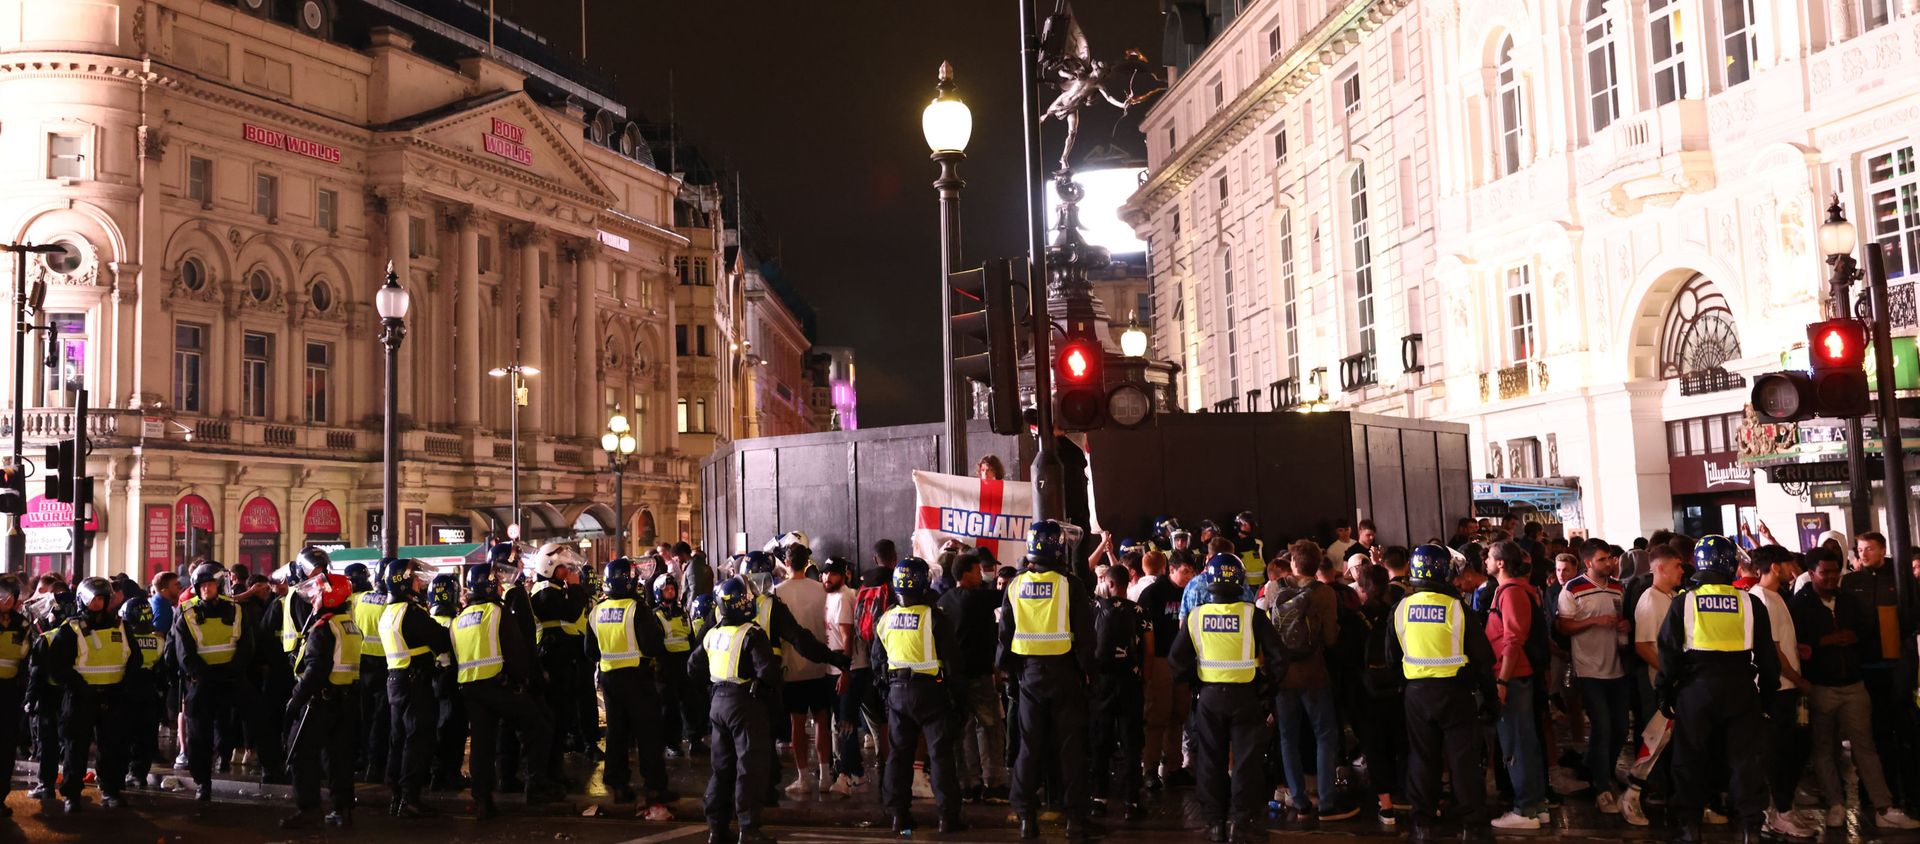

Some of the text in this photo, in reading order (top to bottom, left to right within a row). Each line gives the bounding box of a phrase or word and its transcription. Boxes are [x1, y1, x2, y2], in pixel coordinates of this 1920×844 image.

[494, 117, 526, 144] BODY
[244, 124, 341, 163] BODY WORLDS
[483, 133, 532, 165] WORLDS
[1703, 460, 1750, 488] Lillywhites
[1039, 480, 1045, 489] 7
[1020, 584, 1051, 596] POLICE
[1698, 597, 1737, 610] POLICE
[1409, 607, 1444, 620] POLICE
[890, 614, 918, 628] POLICE
[1204, 617, 1238, 630] POLICE
[137, 637, 158, 649] OLICE
